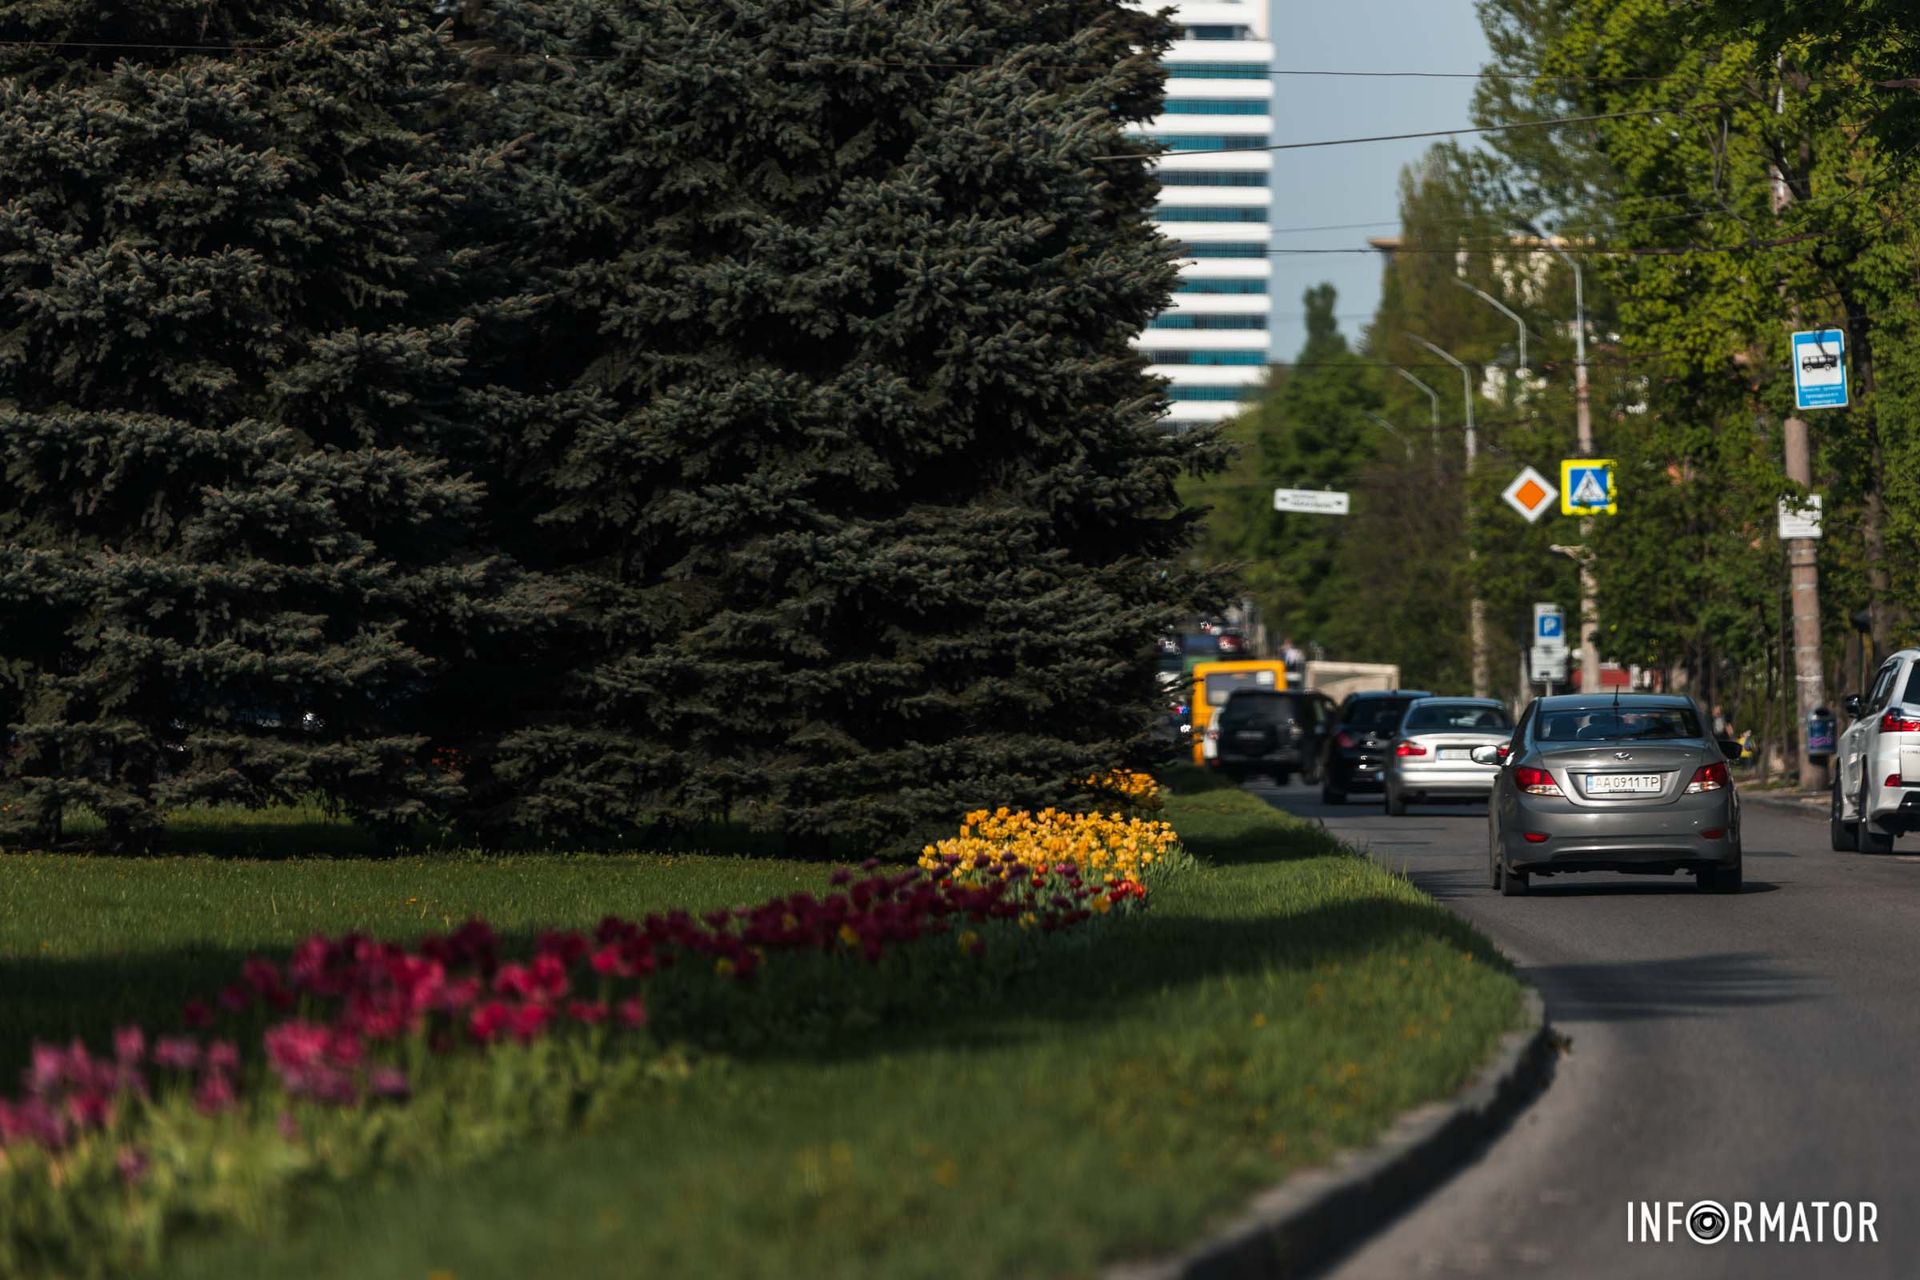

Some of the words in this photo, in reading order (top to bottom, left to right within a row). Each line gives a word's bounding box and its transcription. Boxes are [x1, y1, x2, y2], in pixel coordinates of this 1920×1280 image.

[1595, 777, 1611, 788] AA
[1613, 777, 1640, 788] 0911
[1643, 776, 1659, 787] TP
